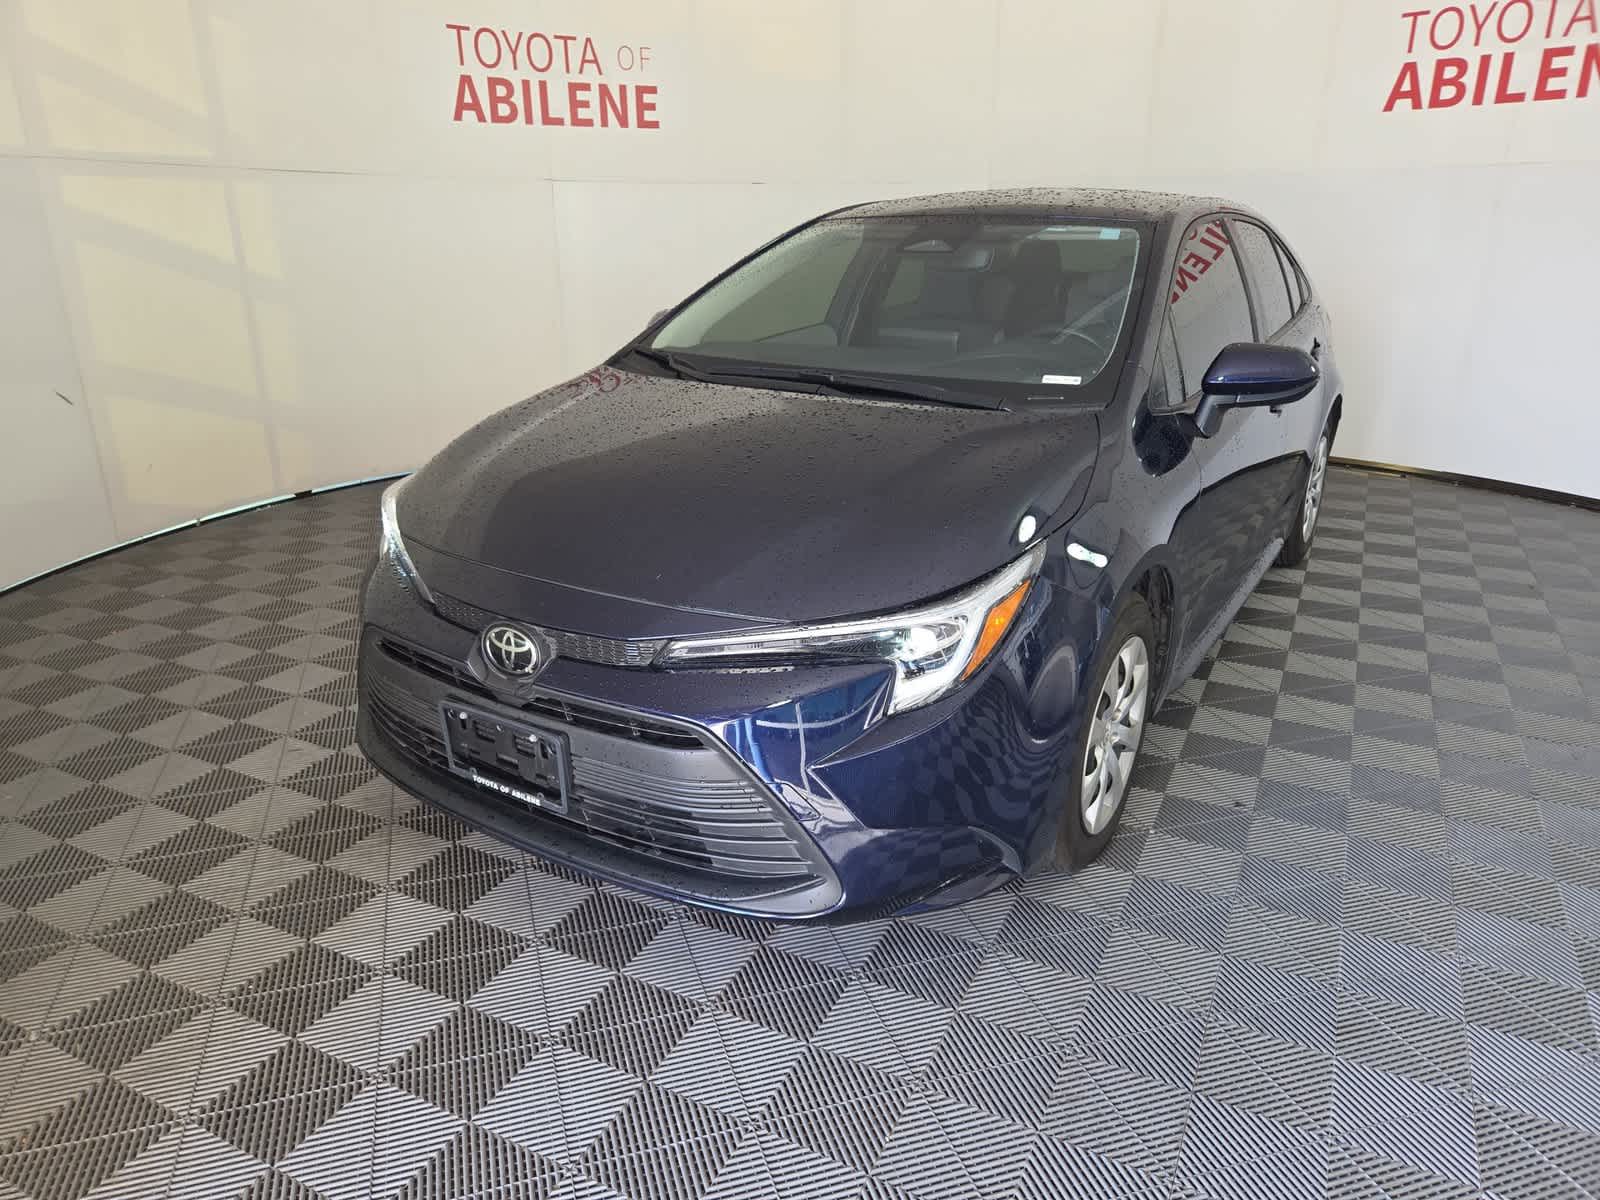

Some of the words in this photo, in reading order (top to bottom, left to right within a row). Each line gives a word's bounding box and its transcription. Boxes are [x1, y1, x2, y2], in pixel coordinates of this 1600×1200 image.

[445, 23, 603, 76] TOYOTA
[617, 45, 652, 72] OF
[1401, 0, 1598, 54] TOYOTA
[453, 74, 660, 129] ABILENE
[472, 774, 499, 791] TOYOTA
[499, 784, 510, 794] OF
